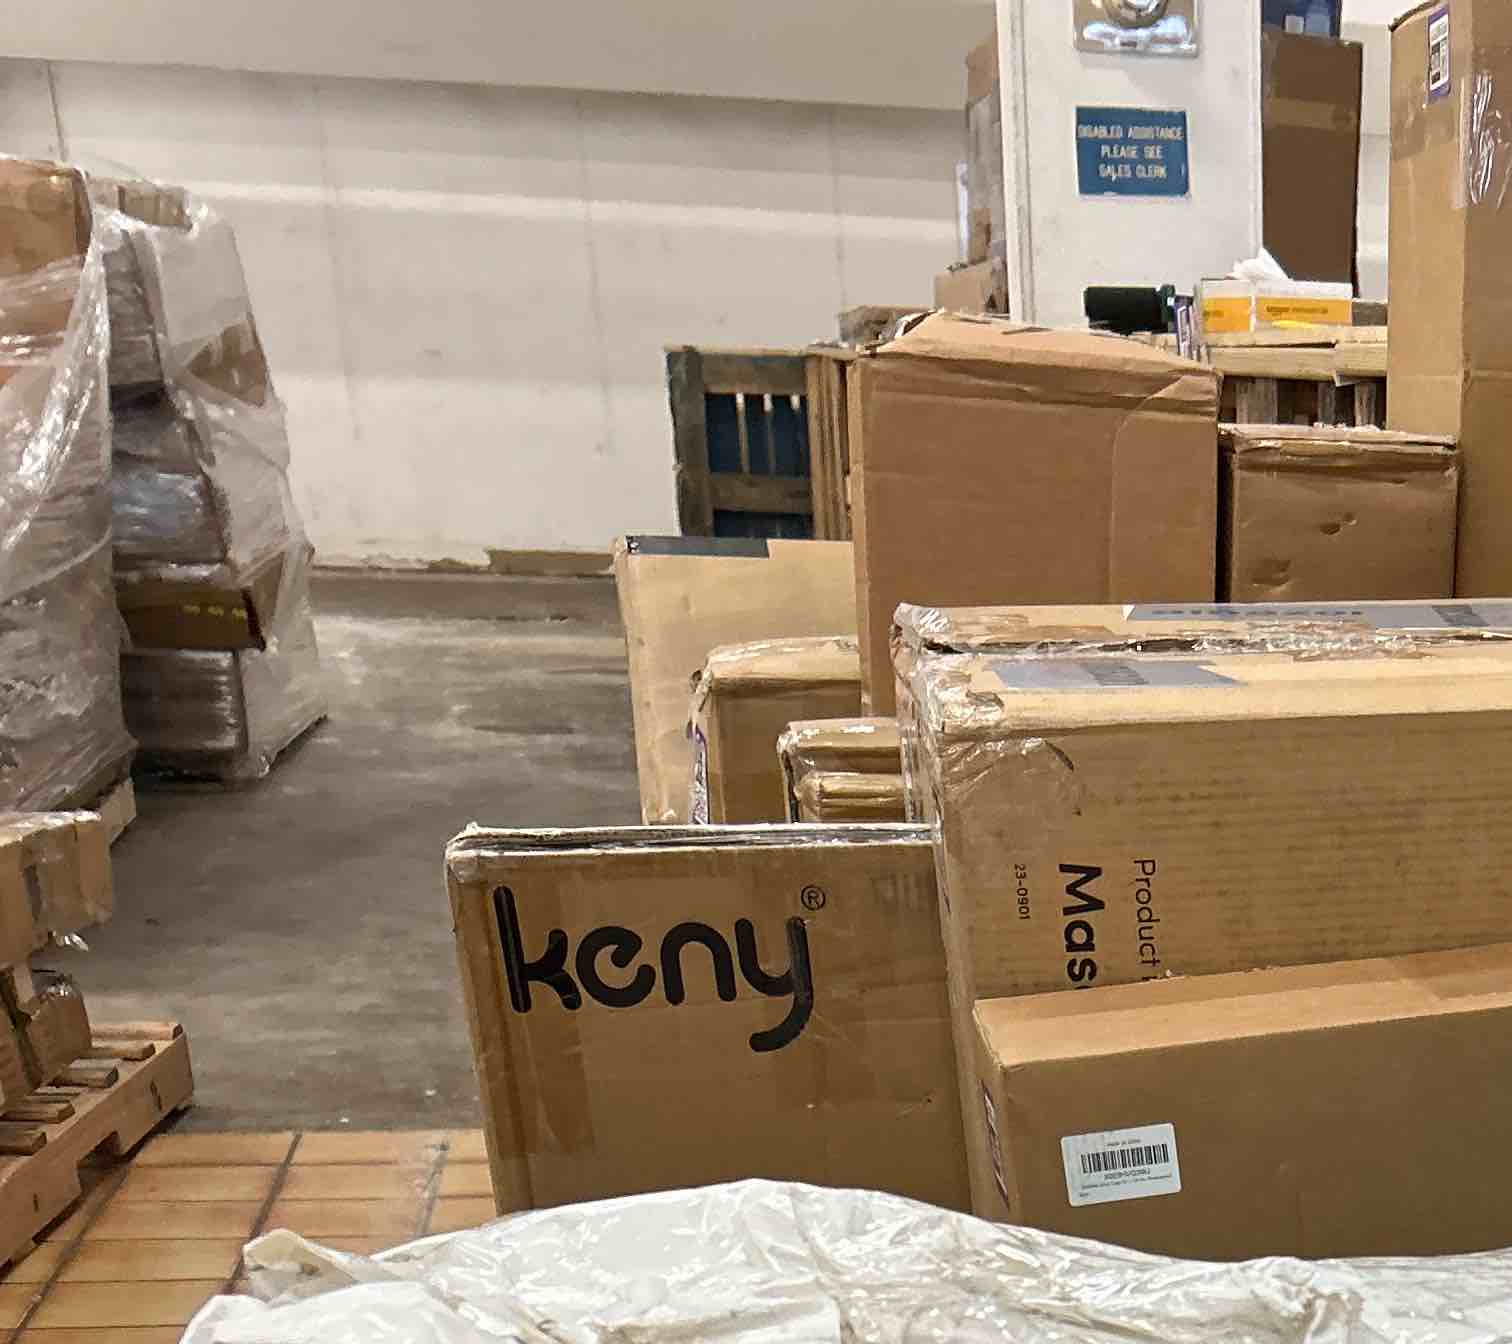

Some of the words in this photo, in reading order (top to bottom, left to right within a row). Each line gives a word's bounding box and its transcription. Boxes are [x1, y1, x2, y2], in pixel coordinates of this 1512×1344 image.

[1077, 124, 1123, 139] DISABLED
[1128, 125, 1184, 140] ASSISTANCE
[1099, 162, 1132, 178] SALES
[1135, 163, 1168, 178] CLERK
[1101, 144, 1138, 160] PLEASE
[1143, 145, 1163, 160] SEE
[1014, 863, 1031, 920] 23-0901
[1059, 863, 1106, 990] Mas
[1133, 859, 1161, 967] Product
